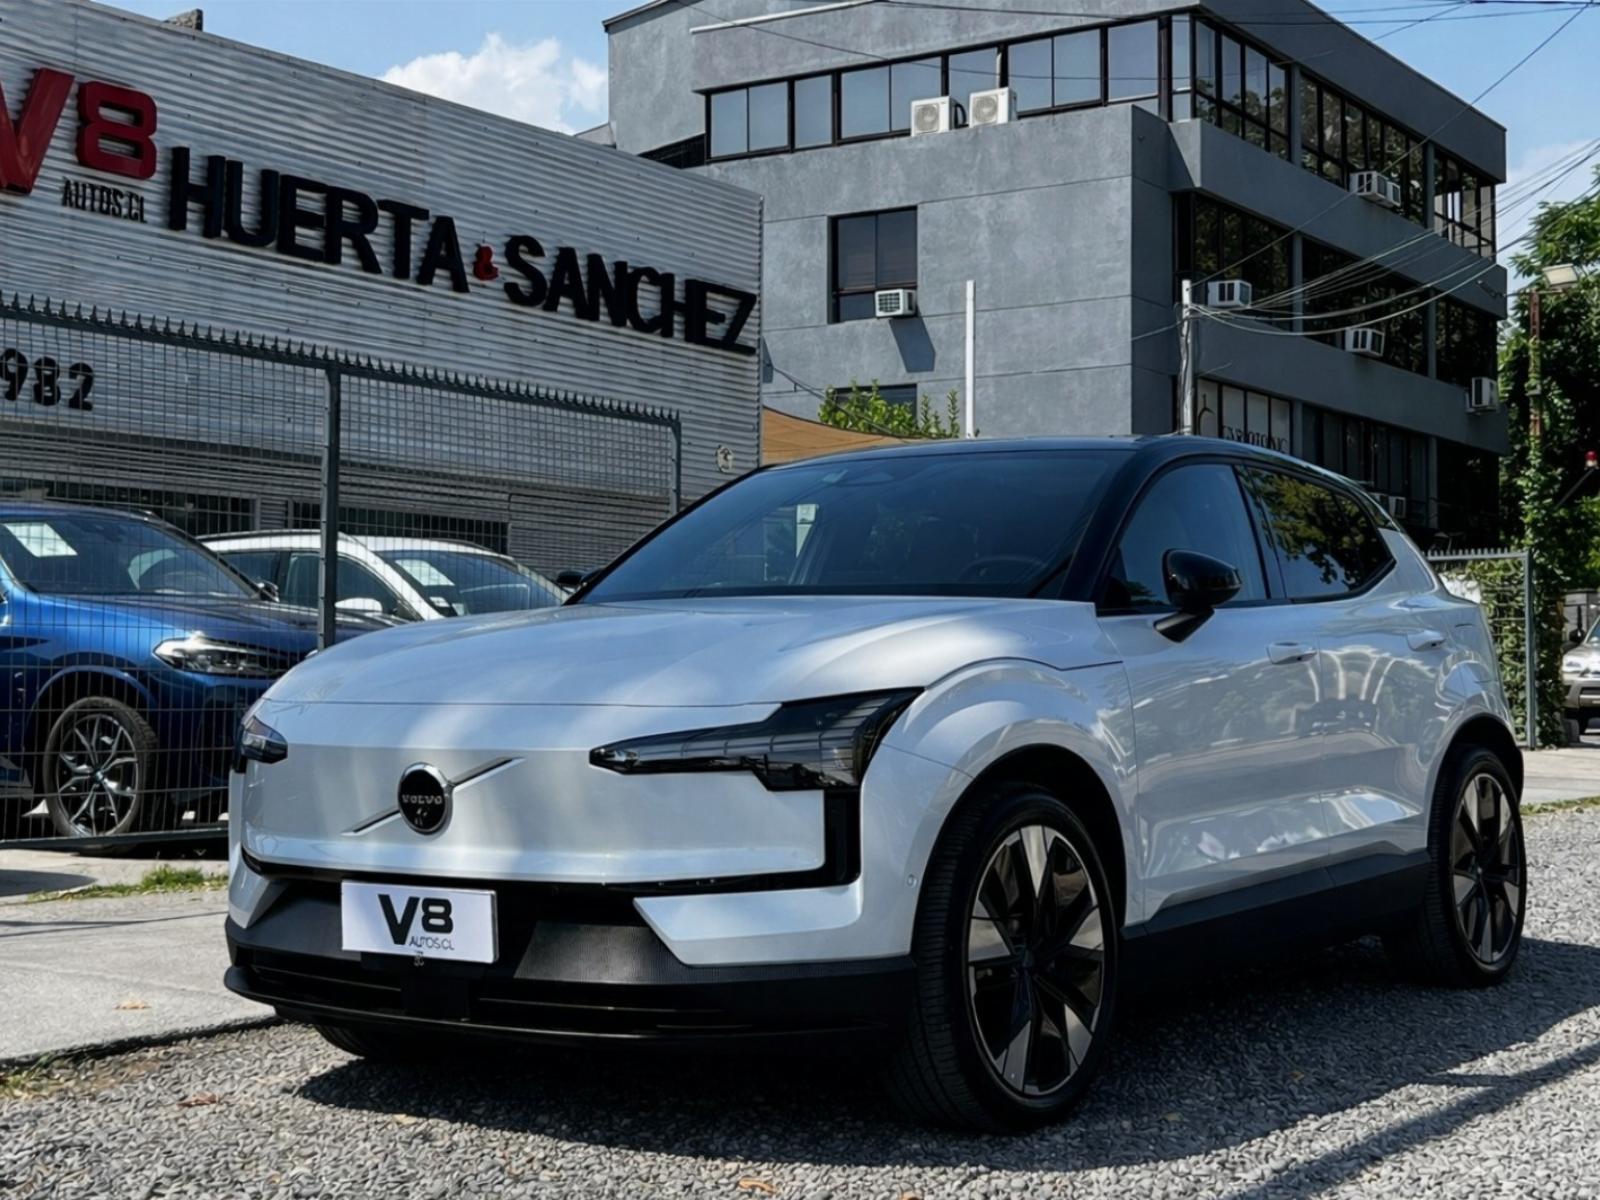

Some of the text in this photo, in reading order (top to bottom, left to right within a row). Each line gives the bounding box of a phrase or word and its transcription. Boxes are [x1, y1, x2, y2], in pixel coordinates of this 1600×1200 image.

[0, 68, 157, 196] V8
[62, 179, 147, 223] AUTOS.CL
[169, 146, 757, 355] HUERTA & SANCHEZ
[0, 348, 93, 411] 982
[402, 794, 442, 805] VOLVO
[378, 894, 453, 945] V8
